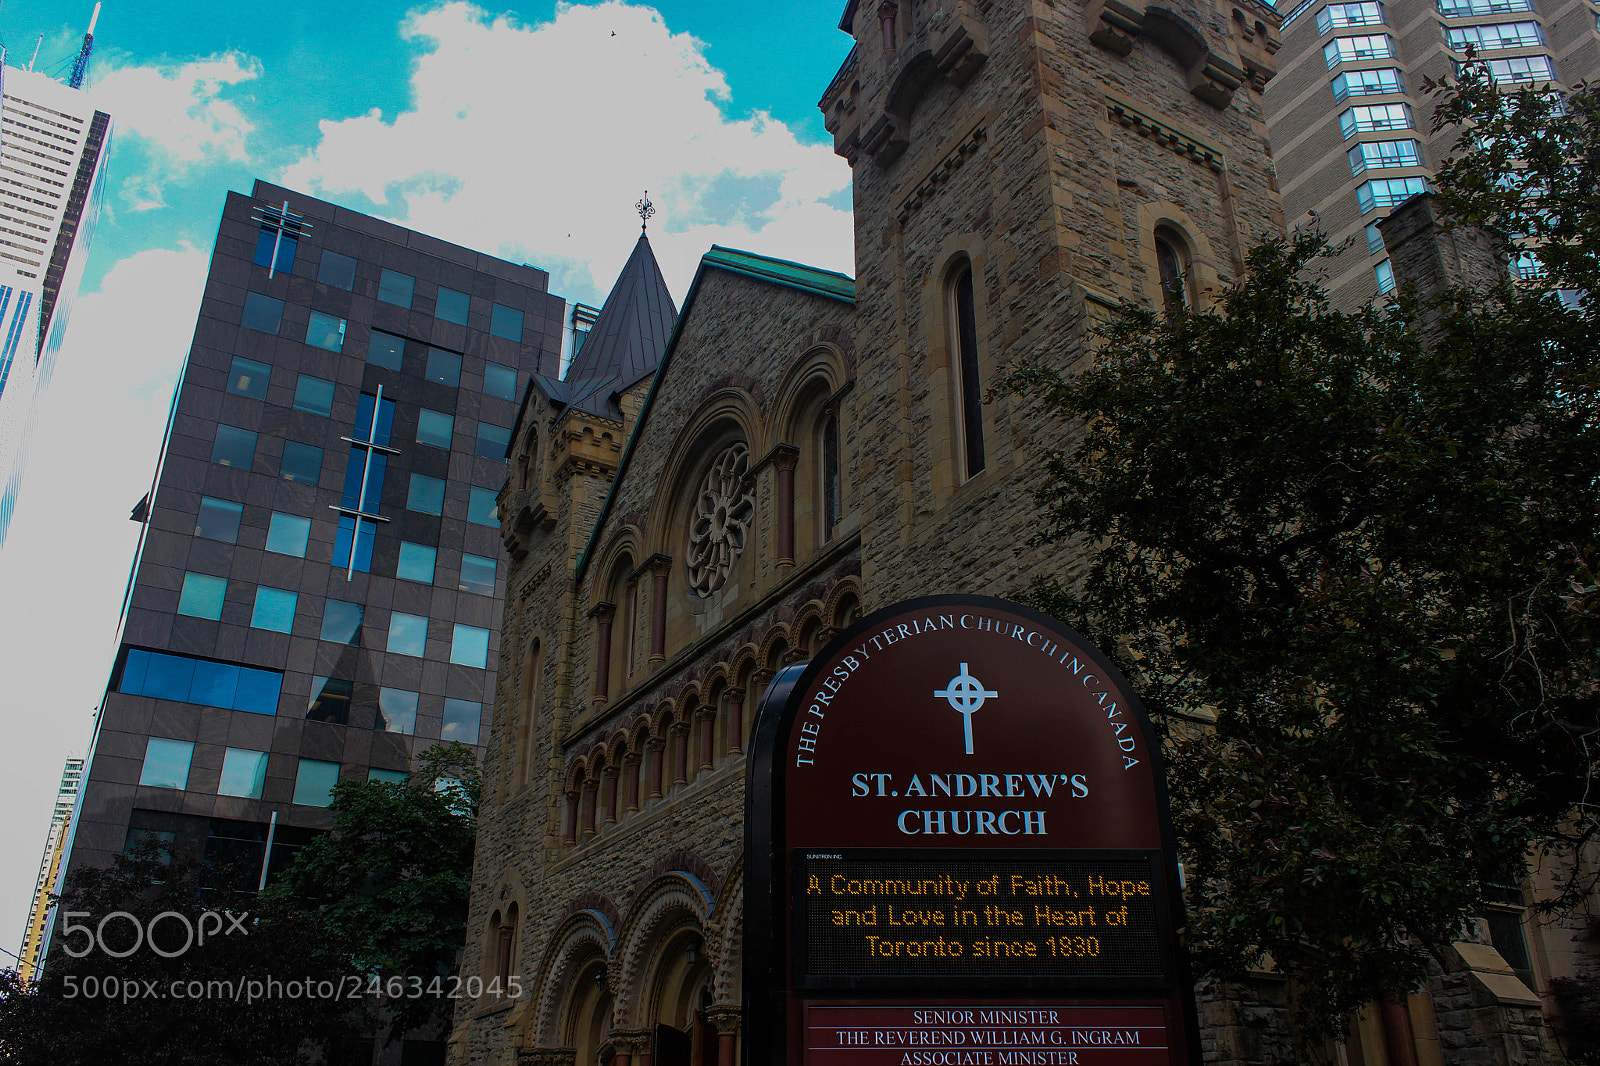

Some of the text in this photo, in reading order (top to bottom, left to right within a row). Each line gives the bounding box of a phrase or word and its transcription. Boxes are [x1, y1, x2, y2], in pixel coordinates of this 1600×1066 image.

[796, 613, 1140, 770] THE PRESBYTERIAN CHURCH IN CANADA
[852, 773, 898, 797] ST.
[897, 810, 1048, 836] CHURCH
[807, 875, 821, 895] A
[831, 875, 969, 900] Community
[977, 875, 999, 896] of
[1088, 876, 1150, 900] Hope
[831, 905, 1128, 926] and Love in the Heart of
[866, 936, 1101, 957] Toronto since 1830
[913, 1011, 1060, 1024] SENIOR MINISTER
[836, 1031, 1141, 1045] THE REVEREND WILLIAM G. INGRAM
[901, 1052, 1080, 1066] ASSOCIATE MINISTER
